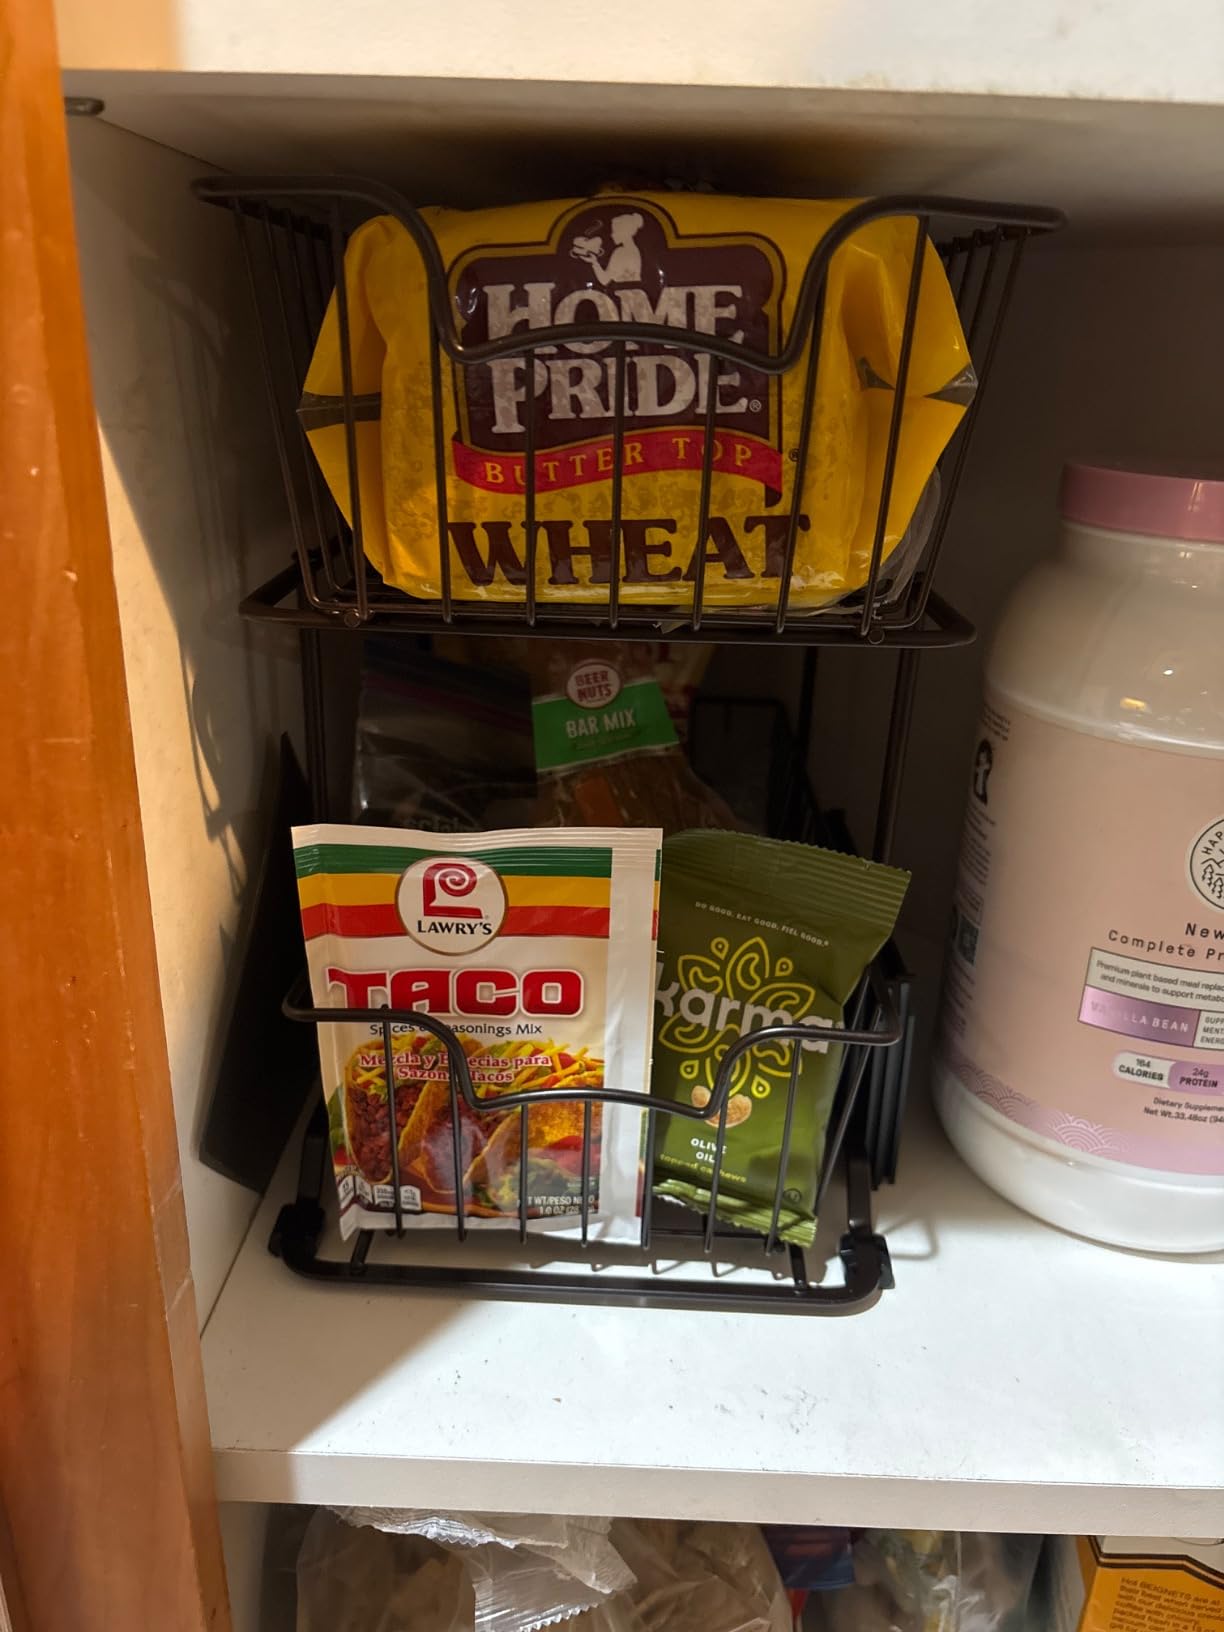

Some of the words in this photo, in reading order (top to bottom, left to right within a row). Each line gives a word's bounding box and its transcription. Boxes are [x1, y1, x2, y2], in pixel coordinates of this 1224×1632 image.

[482, 282, 745, 355] HOME
[483, 441, 646, 484] BUTTER
[671, 437, 752, 467] TOP
[446, 515, 811, 586] WHEAT
[574, 670, 609, 686] BEER
[576, 684, 612, 703] NUTS
[565, 717, 599, 739] BAR
[603, 709, 637, 732] MIX
[417, 920, 493, 935] LAWRY'S
[736, 913, 752, 923] EAT
[1107, 930, 1196, 958] Complete
[1096, 960, 1130, 976] Premium
[1130, 970, 1152, 982] plant
[1153, 974, 1178, 986] based
[1179, 979, 1200, 989] meal
[325, 966, 584, 1020] TACO
[1100, 974, 1115, 984] and
[1116, 978, 1150, 991] minerals
[1151, 984, 1160, 993] to
[1162, 986, 1194, 1001] support
[655, 961, 833, 1055] karma
[1090, 1001, 1147, 1025] VALLA
[1151, 1017, 1189, 1033] BEAN
[369, 1023, 415, 1037] Spces
[516, 1023, 542, 1034] Mix
[423, 1056, 436, 1068] y
[440, 1054, 508, 1068] Eecias
[512, 1055, 551, 1069] para
[398, 1066, 449, 1081] Sazon
[1118, 1065, 1164, 1081] CALORIES
[1179, 1077, 1218, 1088] PROTEIN
[1192, 1068, 1209, 1079] 24g
[1143, 1107, 1158, 1116] Net
[1153, 1097, 1183, 1109] Dietary
[696, 1152, 716, 1164] OIL
[700, 1165, 747, 1184] cahews
[1139, 1580, 1192, 1600] BEIGNETS
